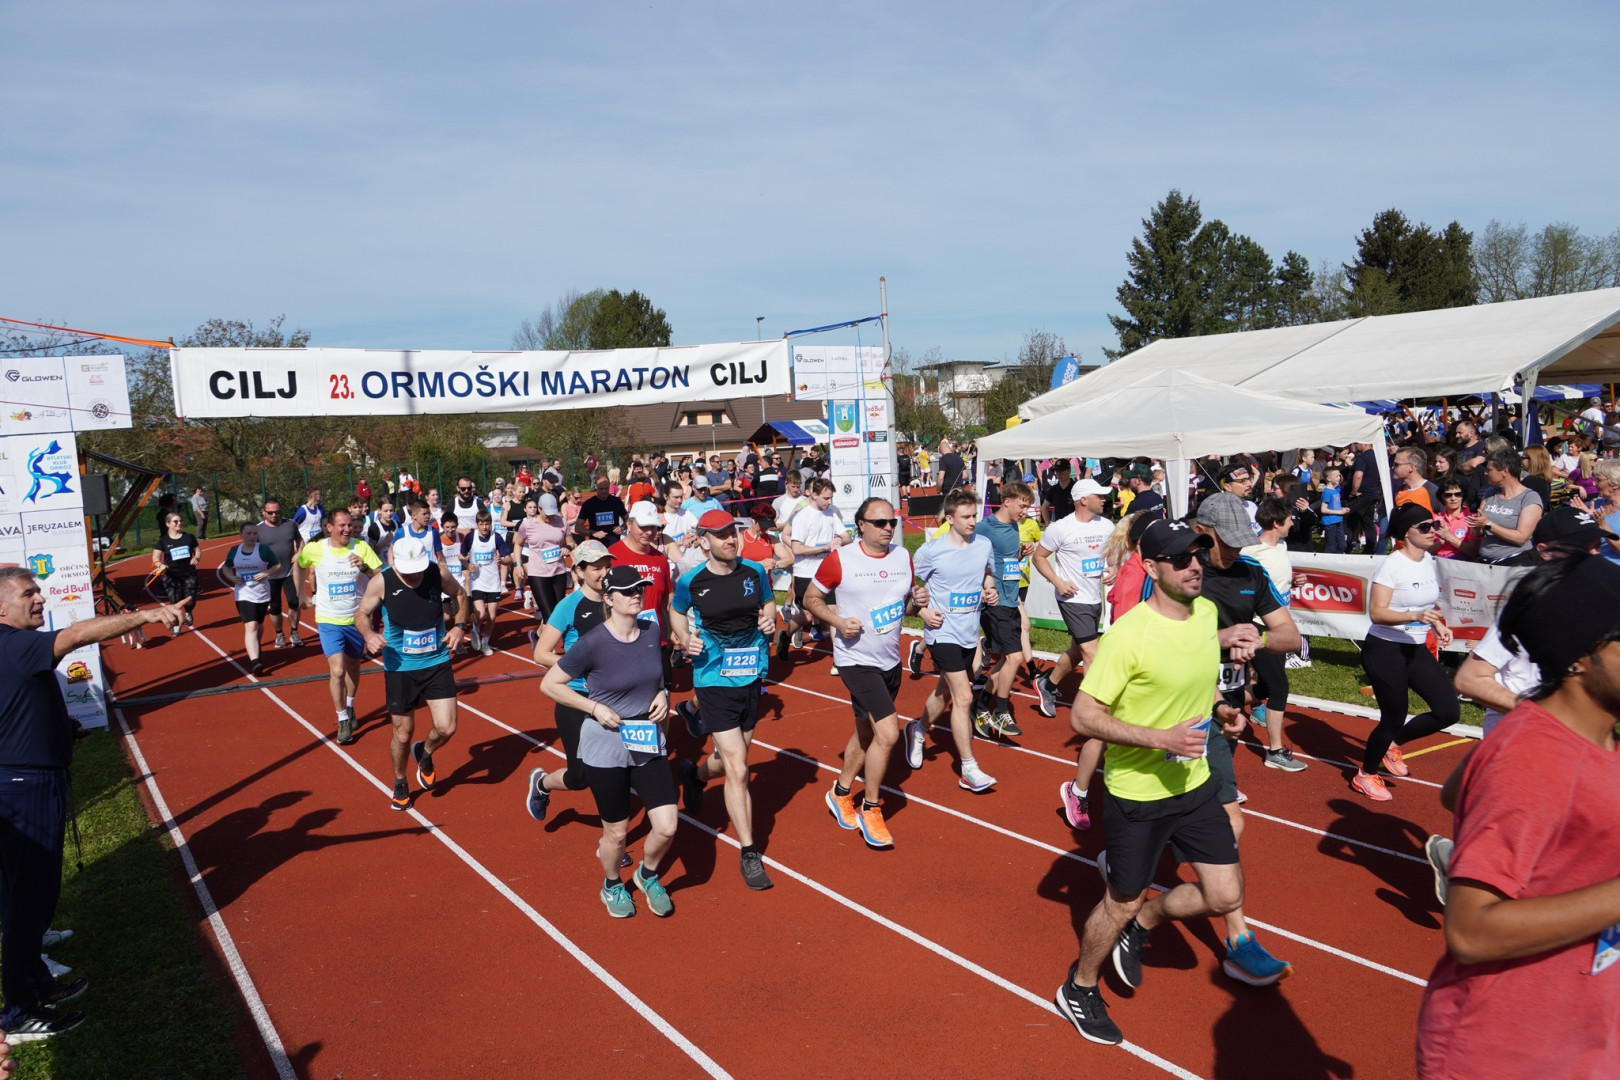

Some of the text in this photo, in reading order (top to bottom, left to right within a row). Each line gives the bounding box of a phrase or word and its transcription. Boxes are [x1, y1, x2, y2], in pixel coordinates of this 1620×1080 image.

[209, 360, 768, 400] CILJ 23. ORMOŠKI MARATON CILJ
[27, 521, 82, 534] JERUZALEM
[60, 564, 89, 572] OBČINA
[61, 571, 90, 579] ORMOŽ
[49, 583, 89, 595] Red Bull
[331, 584, 355, 594] 1288
[952, 594, 979, 605] 1163
[874, 605, 903, 624] 1152
[405, 634, 434, 646] 1406
[725, 655, 757, 666] 1228
[621, 729, 654, 741] 1207
